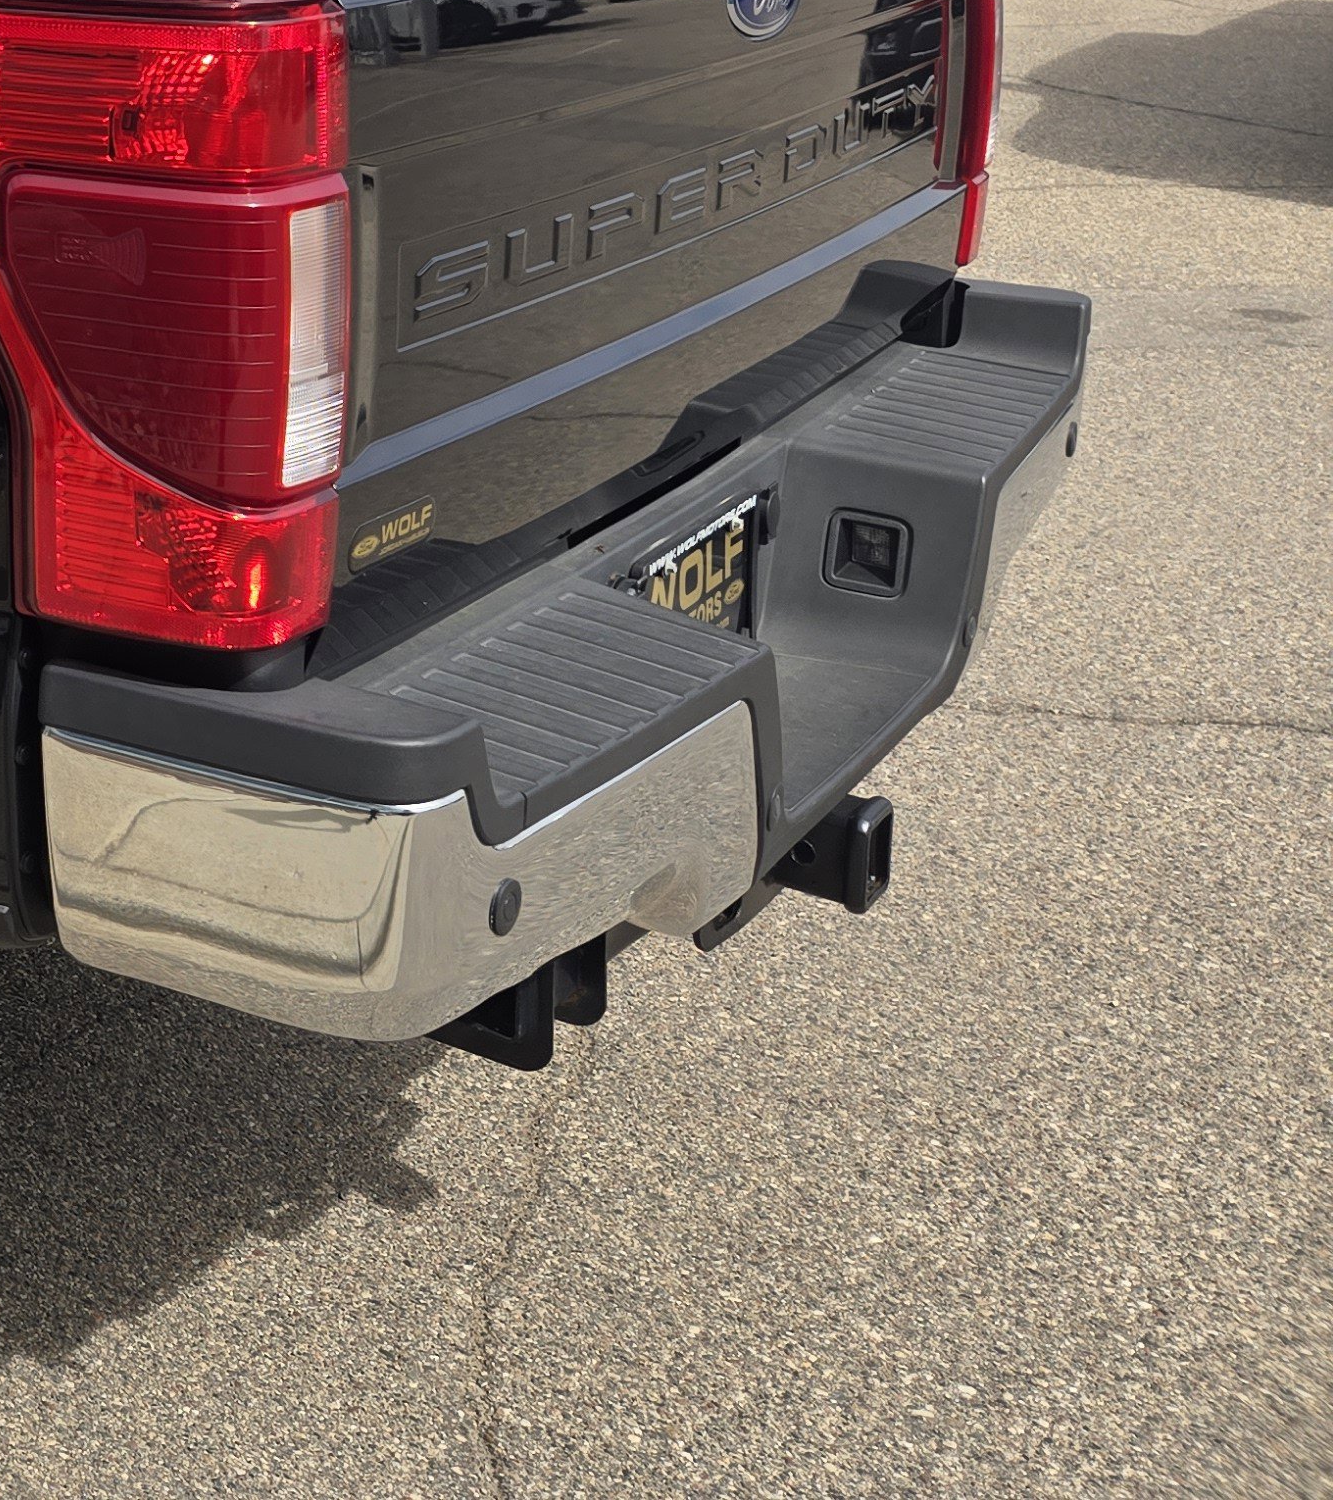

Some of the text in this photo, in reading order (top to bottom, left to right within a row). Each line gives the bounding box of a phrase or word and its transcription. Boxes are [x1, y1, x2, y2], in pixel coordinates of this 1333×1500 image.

[413, 74, 940, 322] SUPER DUTY
[381, 503, 433, 544] WOLF
